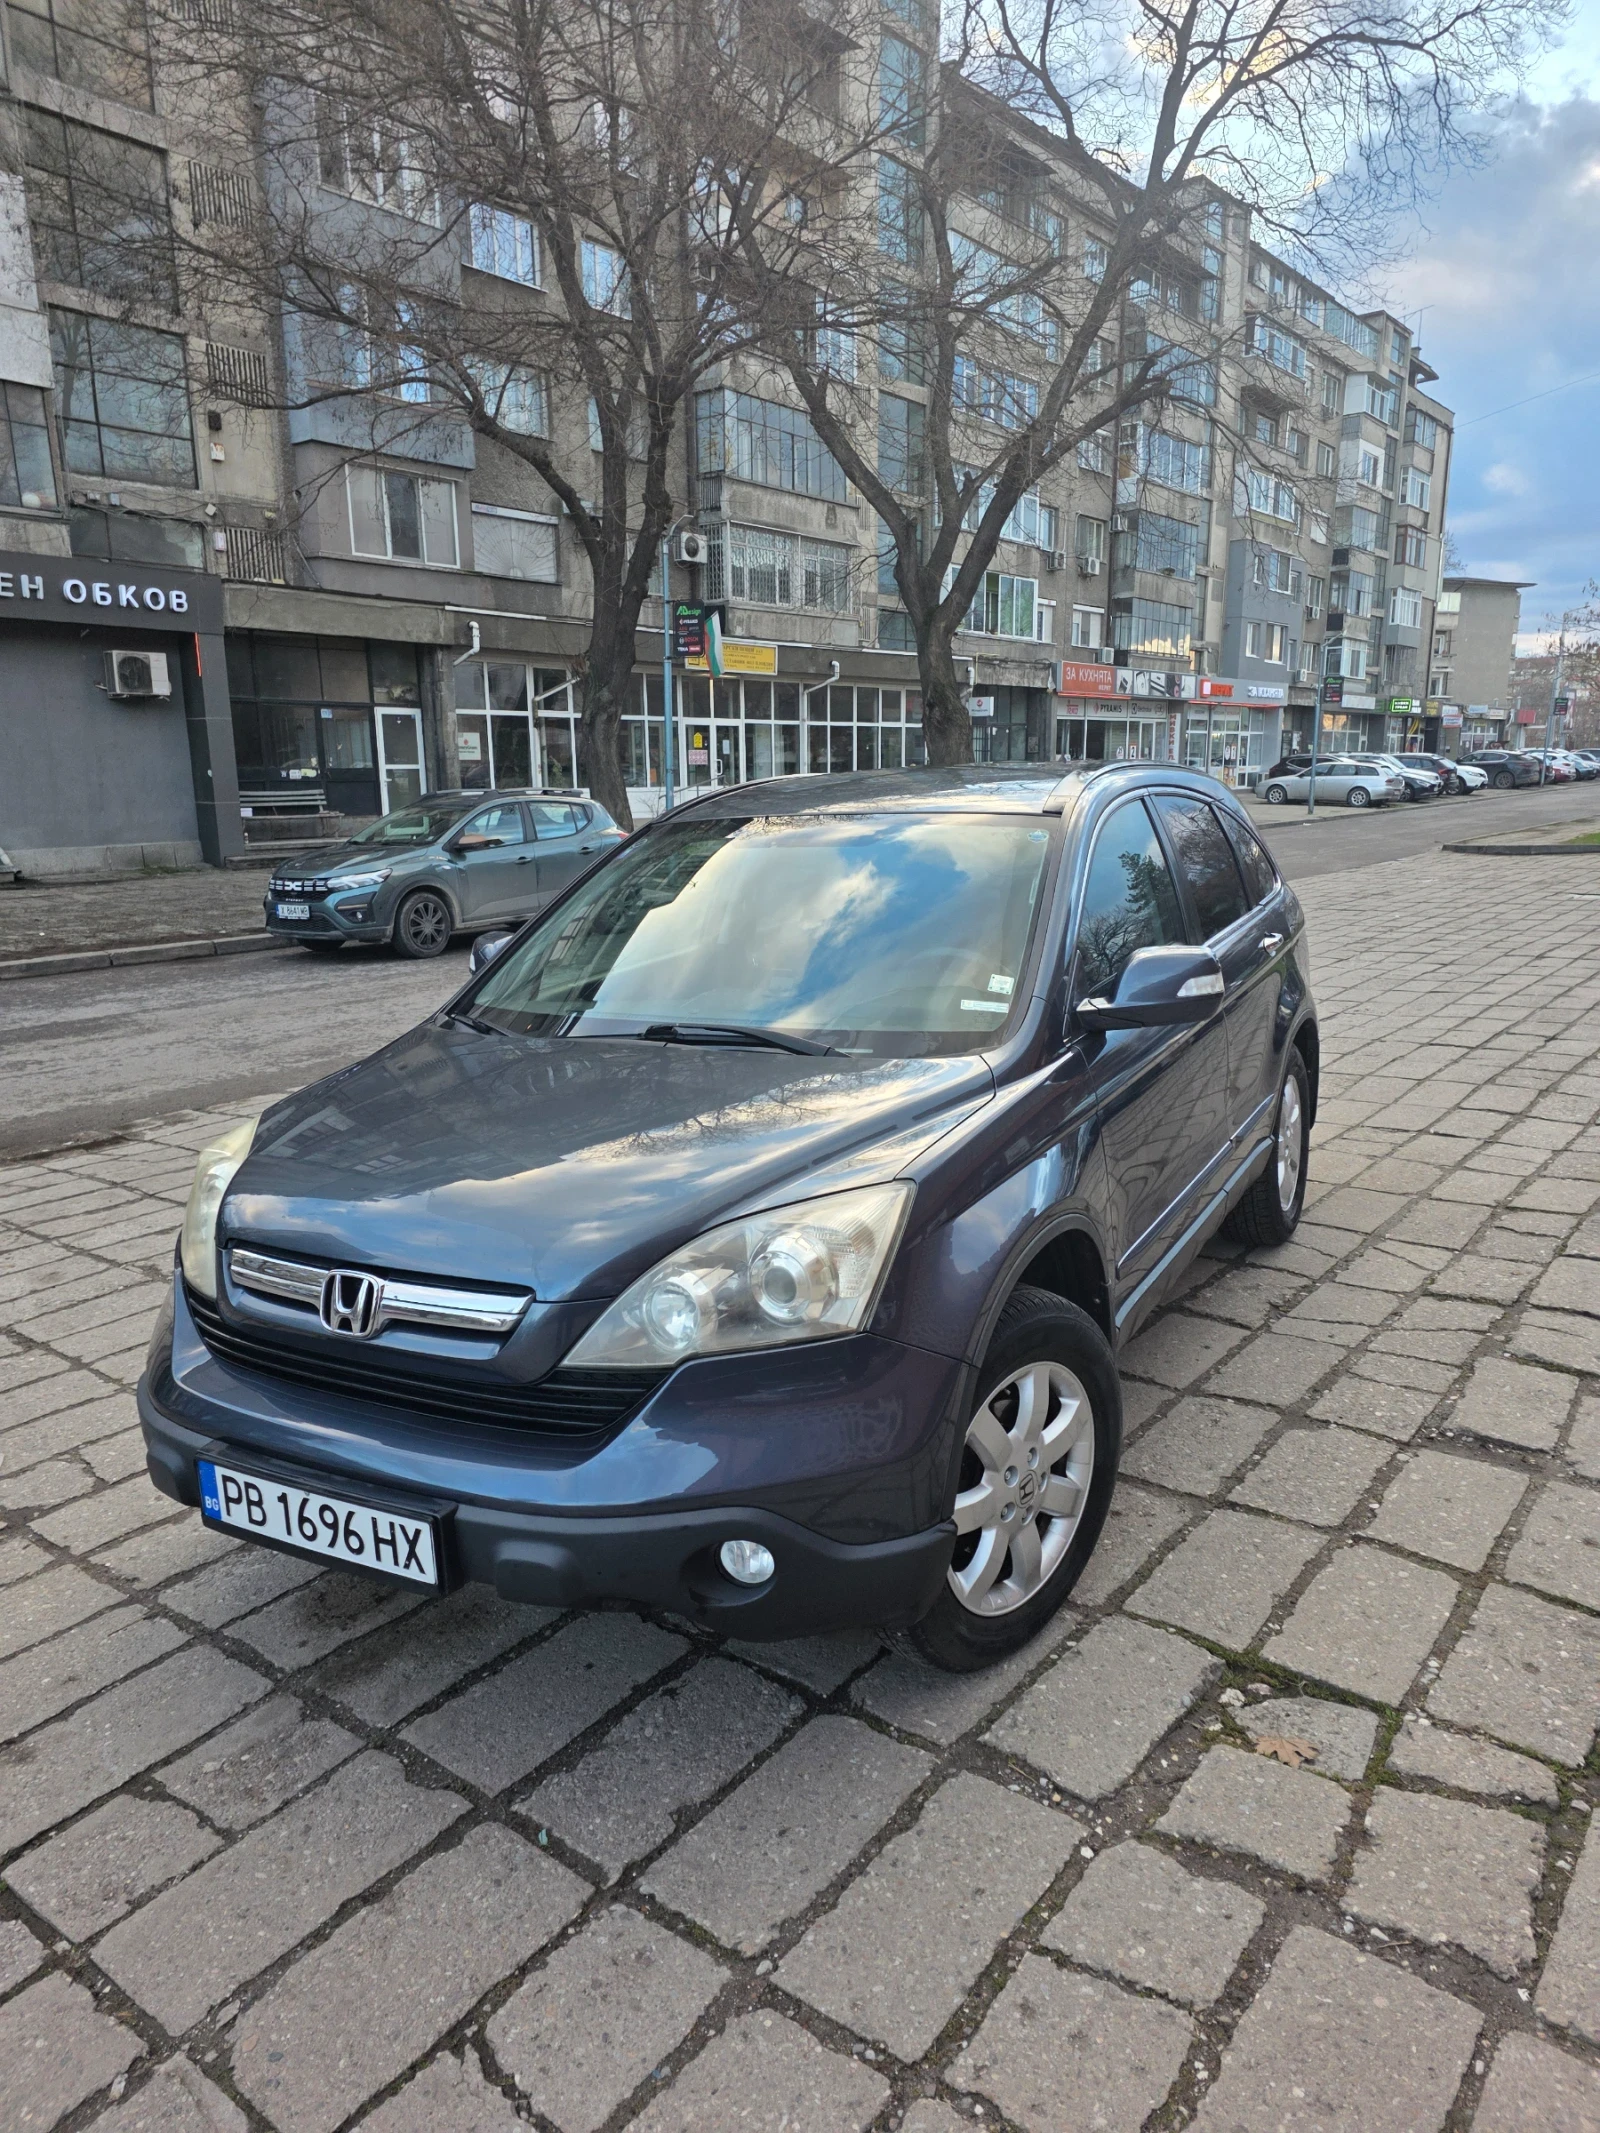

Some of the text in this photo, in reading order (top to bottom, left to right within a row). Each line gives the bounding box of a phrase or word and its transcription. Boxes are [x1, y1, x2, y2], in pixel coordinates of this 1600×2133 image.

[62, 578, 188, 613] ОБКОВ
[1065, 667, 1112, 684] ЗА КУХНЯТА
[1100, 704, 1123, 713] PYRAMIS
[205, 1473, 427, 1575] BG PB 1696 HX
